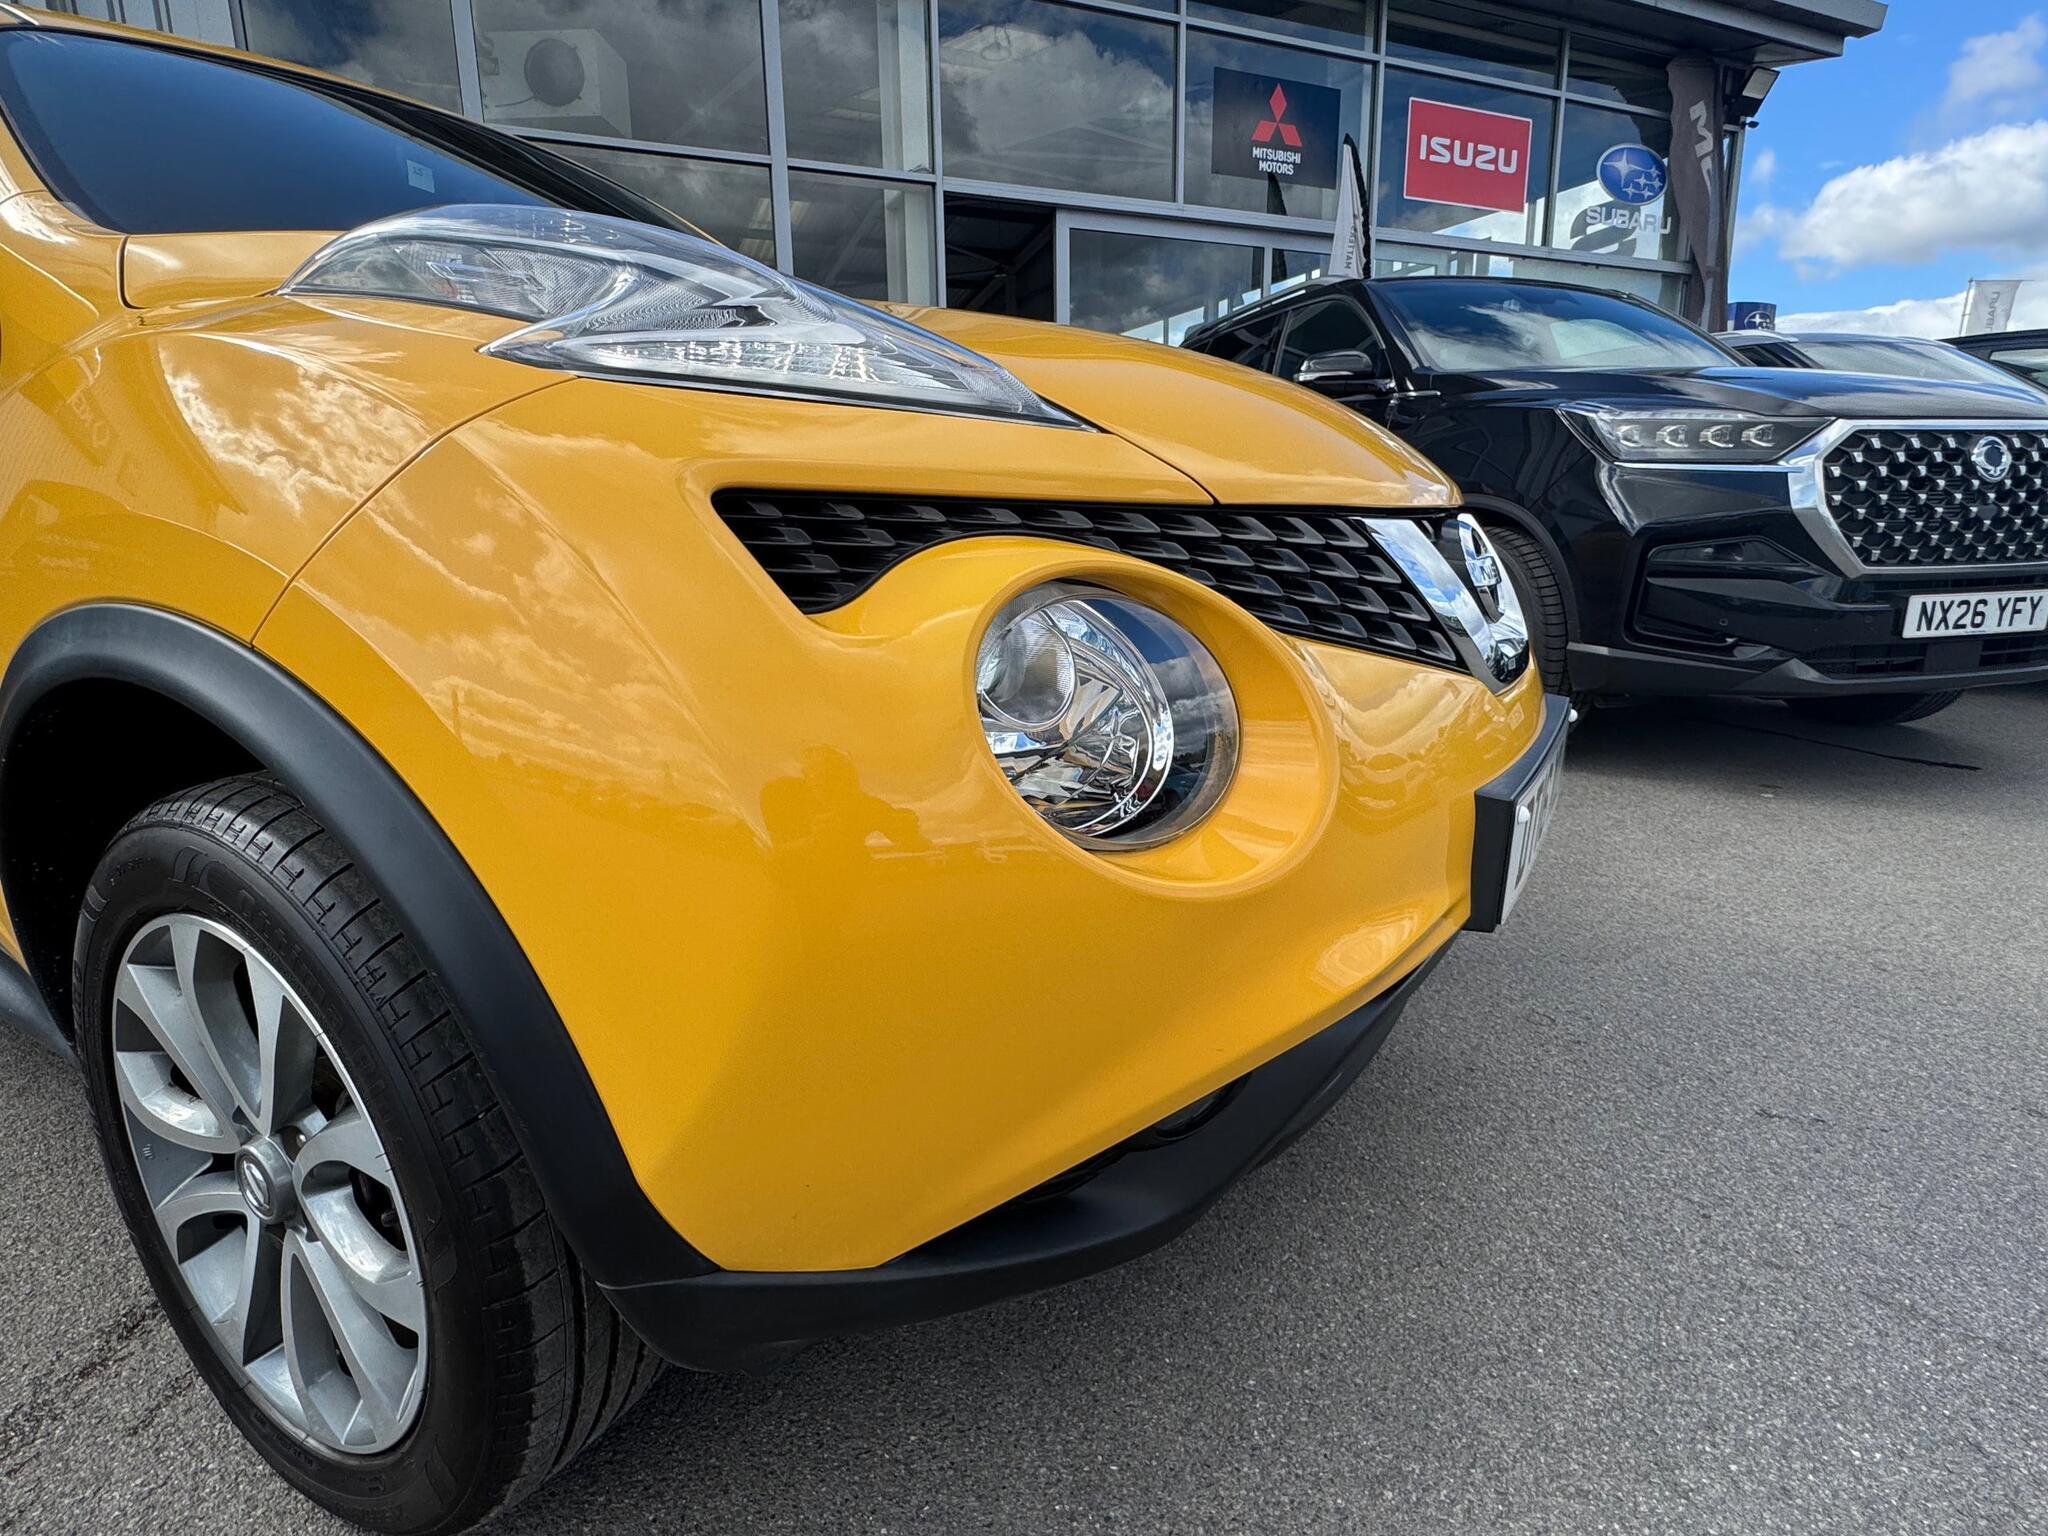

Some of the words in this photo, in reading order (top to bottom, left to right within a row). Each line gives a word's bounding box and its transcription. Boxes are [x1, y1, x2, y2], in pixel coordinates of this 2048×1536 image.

[1252, 146, 1301, 164] MITSUBISHI
[1259, 160, 1294, 175] MOTORS
[1419, 134, 1518, 174] ISUZU
[1584, 206, 1672, 234] SUBARU
[1916, 599, 1988, 632] NX26
[1996, 595, 2043, 628] YFY
